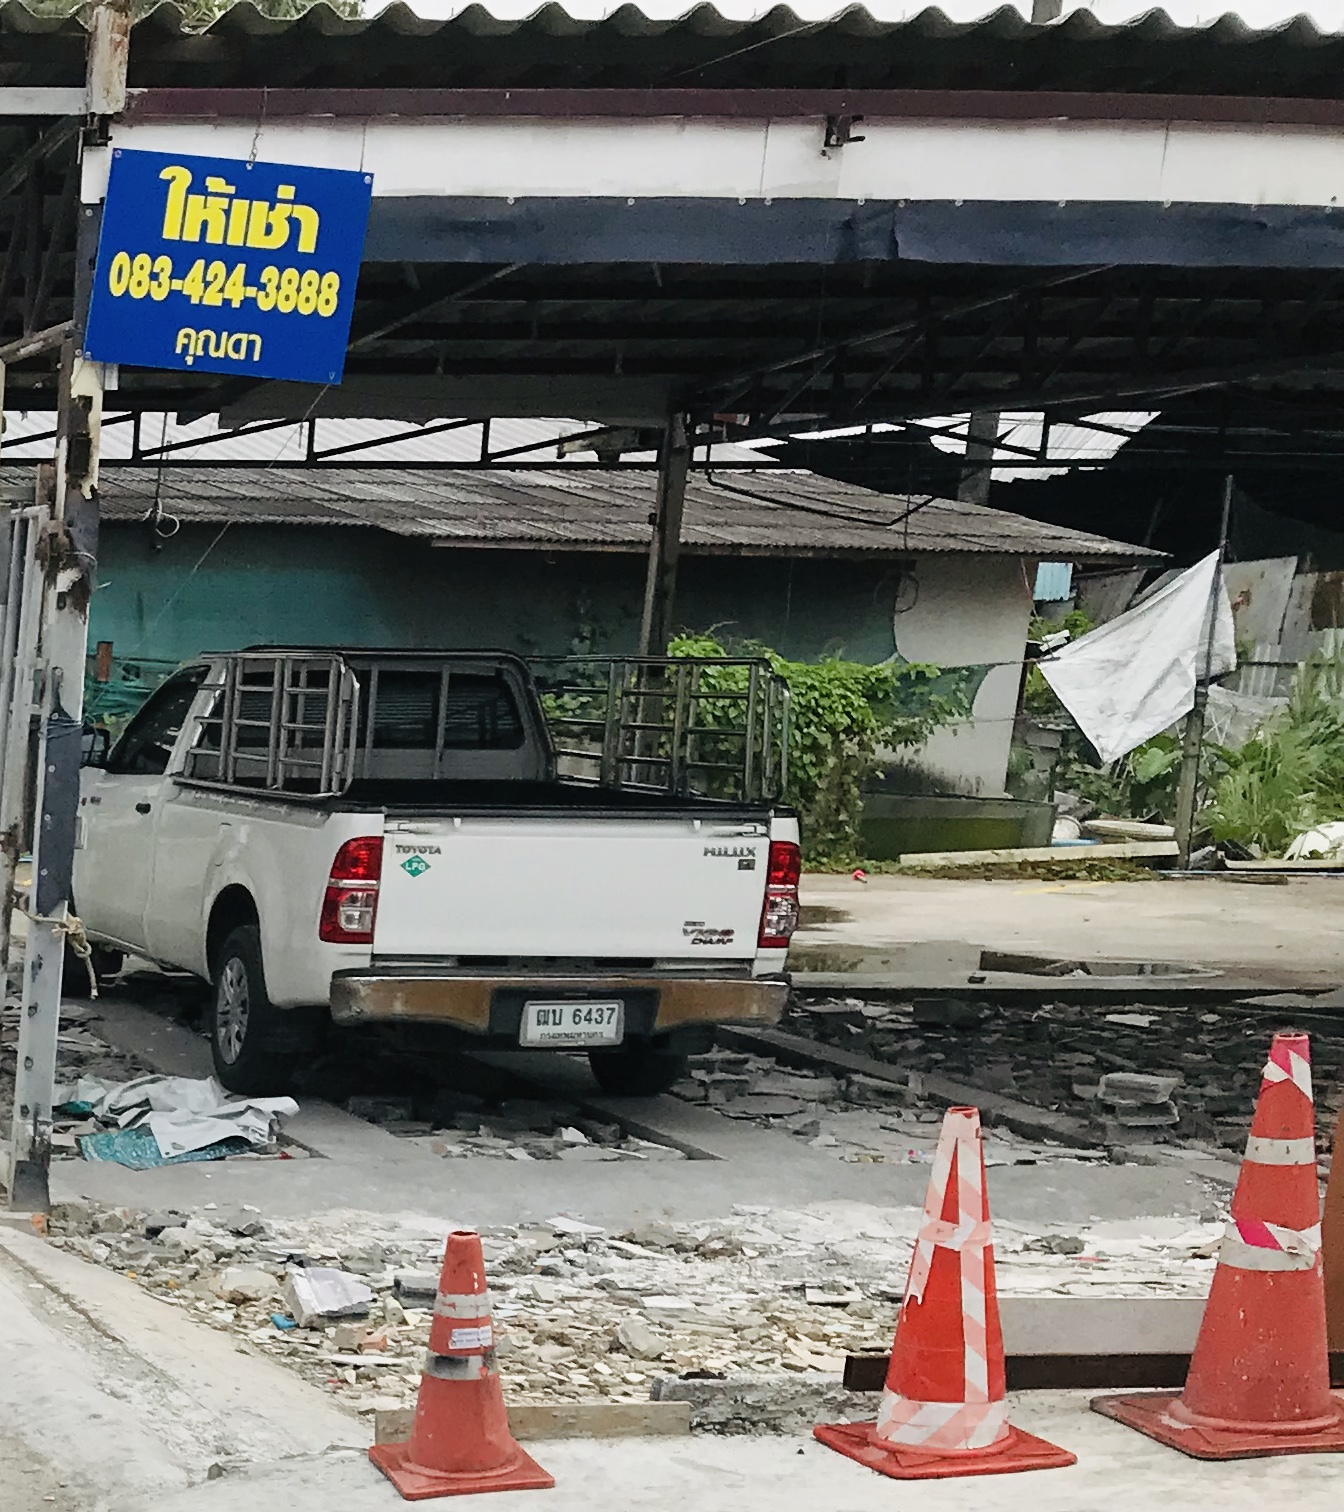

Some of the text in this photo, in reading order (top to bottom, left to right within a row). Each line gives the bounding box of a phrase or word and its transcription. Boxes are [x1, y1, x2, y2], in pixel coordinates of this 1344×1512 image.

[158, 165, 320, 254] ให้เช่า
[108, 251, 341, 318] 083-424-3888
[395, 844, 442, 855] TOYOTA
[405, 862, 427, 871] LPG
[572, 1007, 617, 1026] 6437
